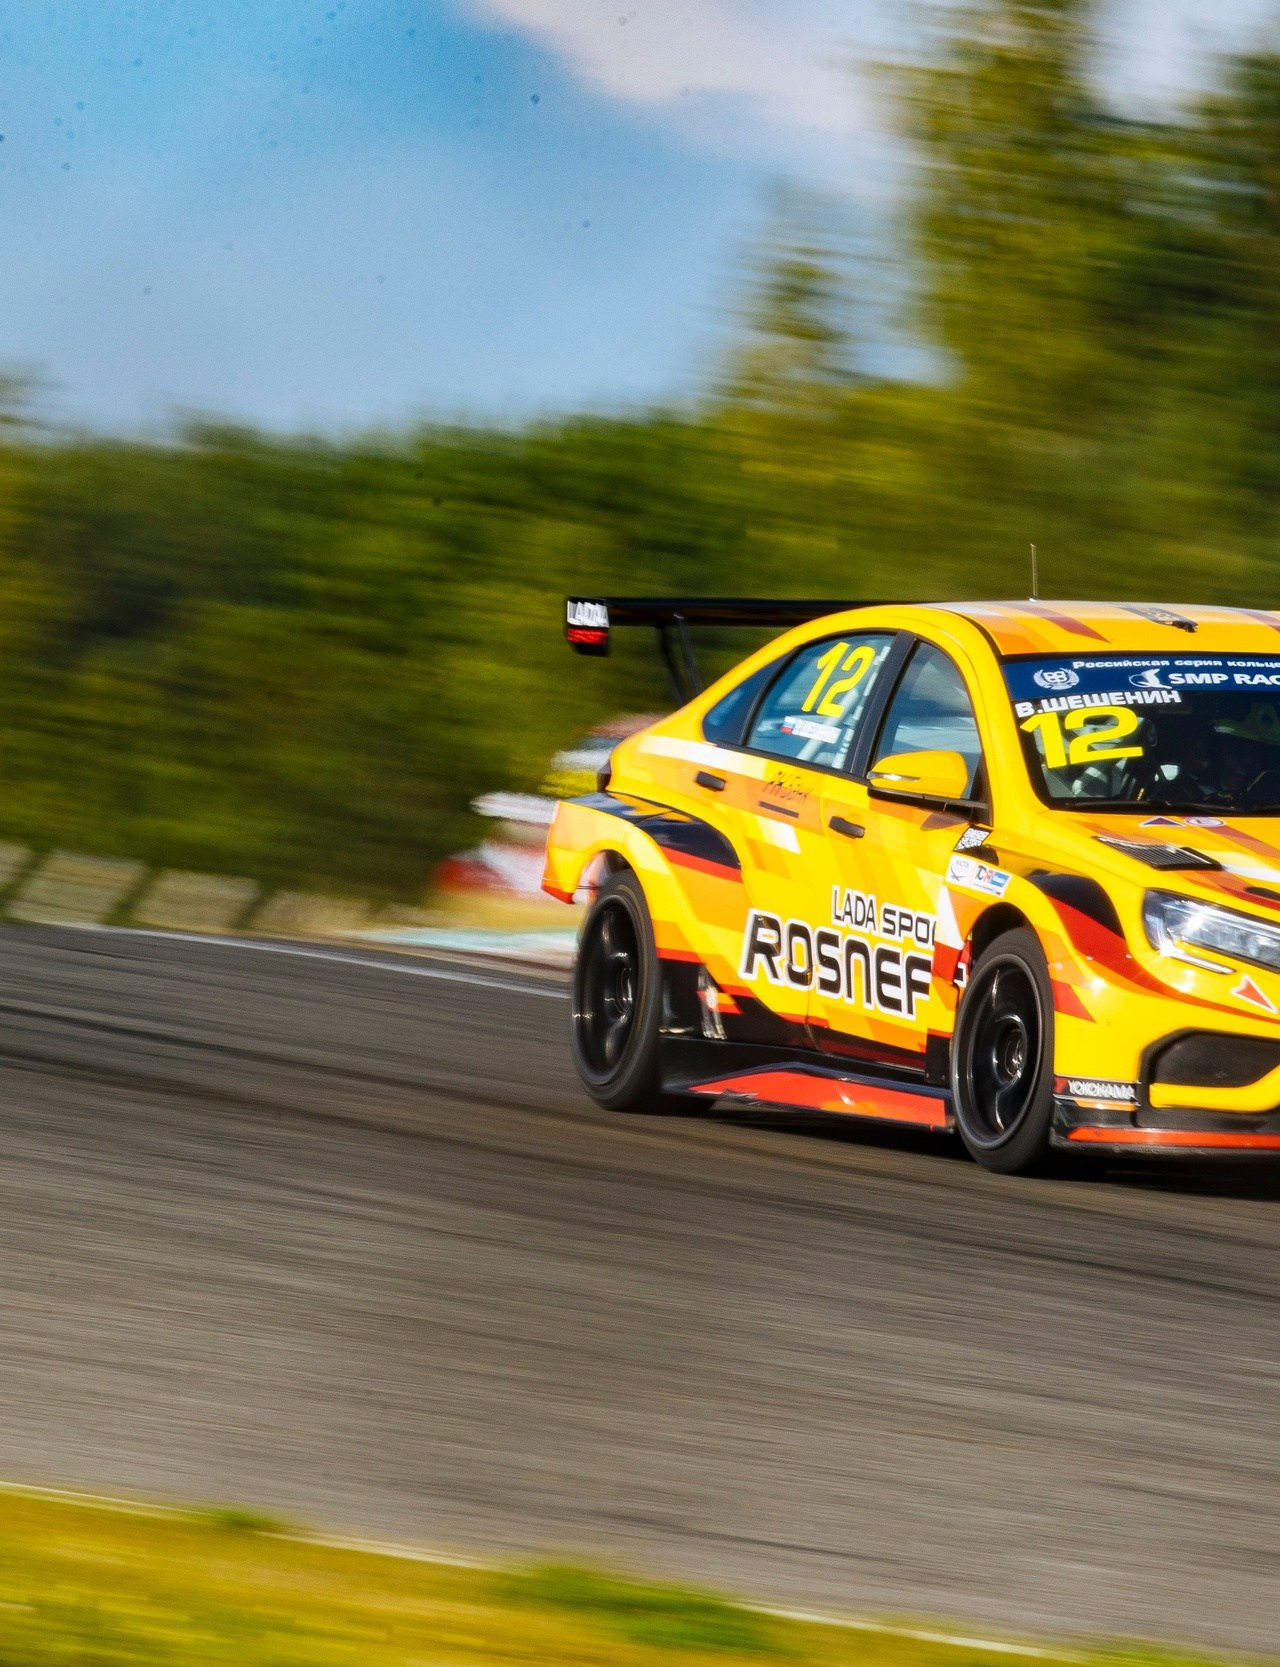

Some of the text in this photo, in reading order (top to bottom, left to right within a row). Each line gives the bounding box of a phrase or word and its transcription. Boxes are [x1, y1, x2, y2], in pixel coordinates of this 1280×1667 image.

[567, 600, 609, 627] LADA
[801, 641, 876, 718] 12
[1072, 659, 1170, 669] Российская
[1174, 660, 1223, 668] серия
[1168, 673, 1229, 685] SMP
[1015, 690, 1182, 718] В.ШЕШЕНИН
[1019, 705, 1144, 769] 12
[832, 887, 878, 932] LADA
[882, 906, 935, 947] SPO
[741, 911, 932, 1018] ROSNEF
[1067, 1080, 1137, 1100] YOKOHAMA
